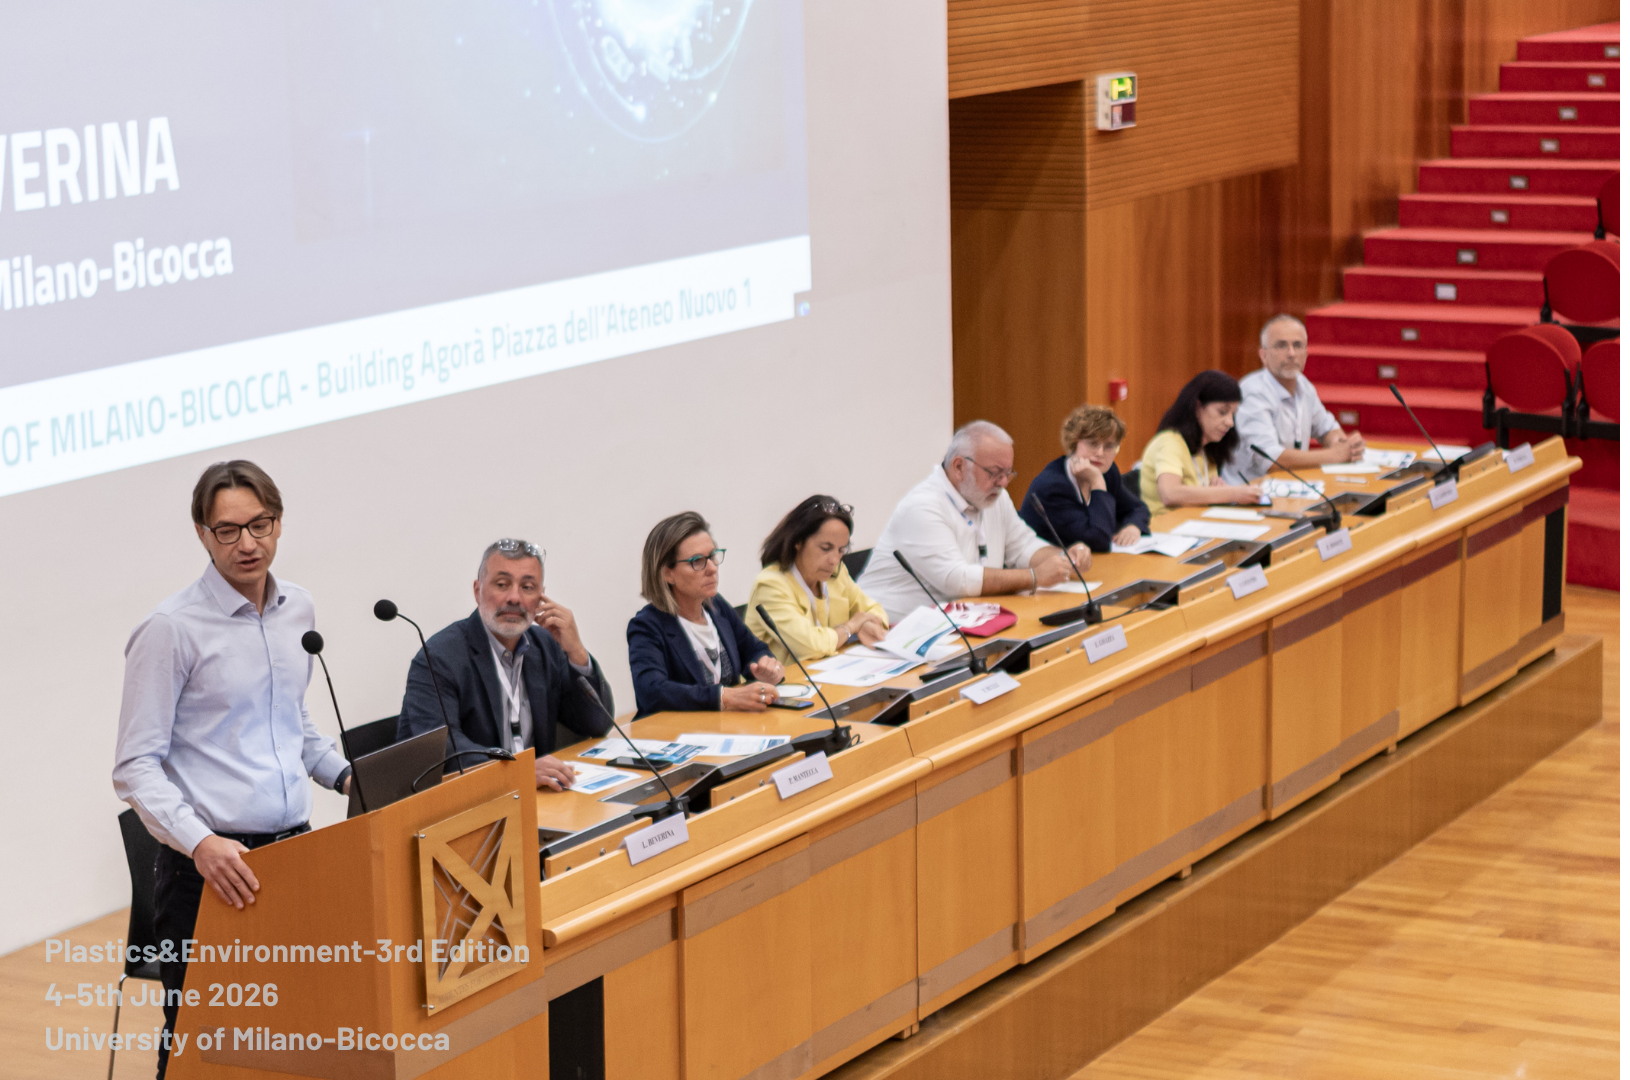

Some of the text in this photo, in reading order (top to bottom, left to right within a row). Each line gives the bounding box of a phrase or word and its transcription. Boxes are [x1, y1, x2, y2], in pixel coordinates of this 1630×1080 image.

[0, 116, 180, 212] ERINA
[2, 420, 40, 467] OF
[51, 370, 293, 457] MILANO-BICOCCA
[318, 348, 415, 398] Building
[420, 327, 485, 383] Agorà
[492, 322, 558, 360] Piazza
[564, 300, 674, 344] dell'Ateneo
[679, 288, 738, 320] Nuovo
[744, 277, 752, 307] 1
